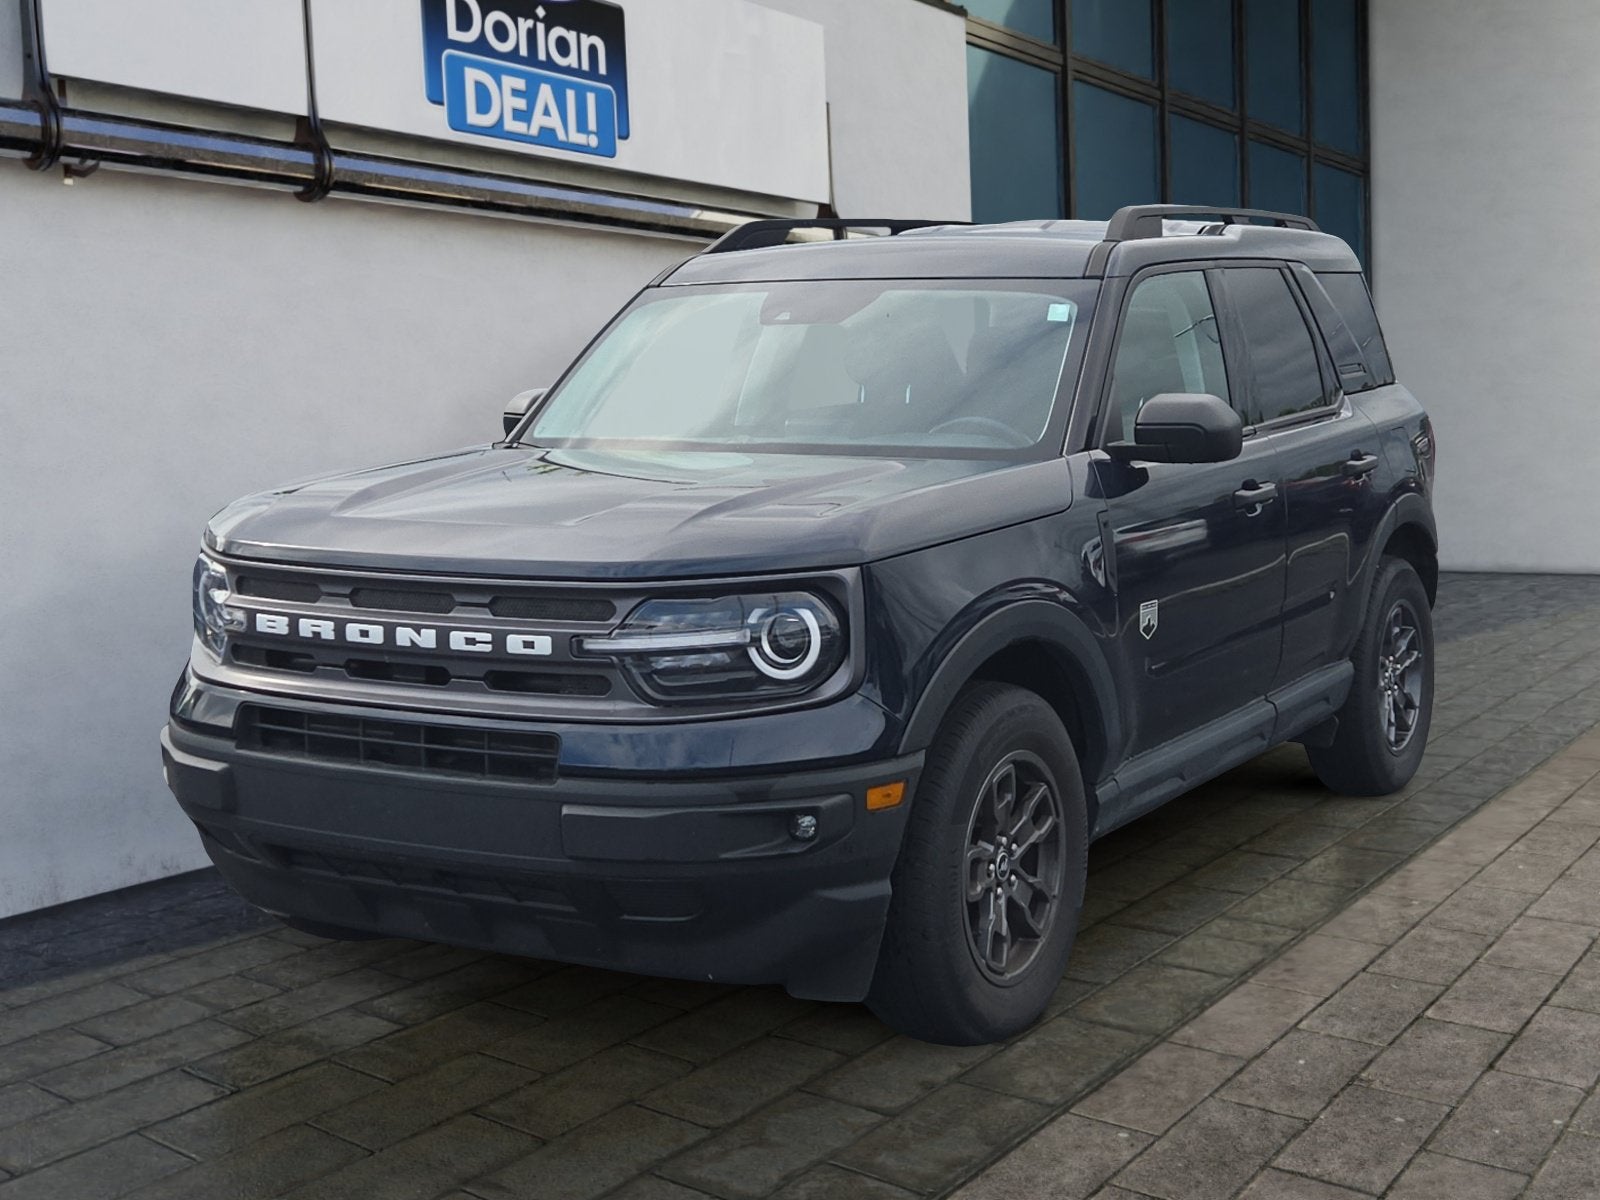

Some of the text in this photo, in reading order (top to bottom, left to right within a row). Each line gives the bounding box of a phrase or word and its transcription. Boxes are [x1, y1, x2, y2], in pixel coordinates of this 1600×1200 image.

[446, 0, 607, 75] Dorian
[464, 66, 599, 149] DEAL!
[255, 613, 552, 656] BRONCO
